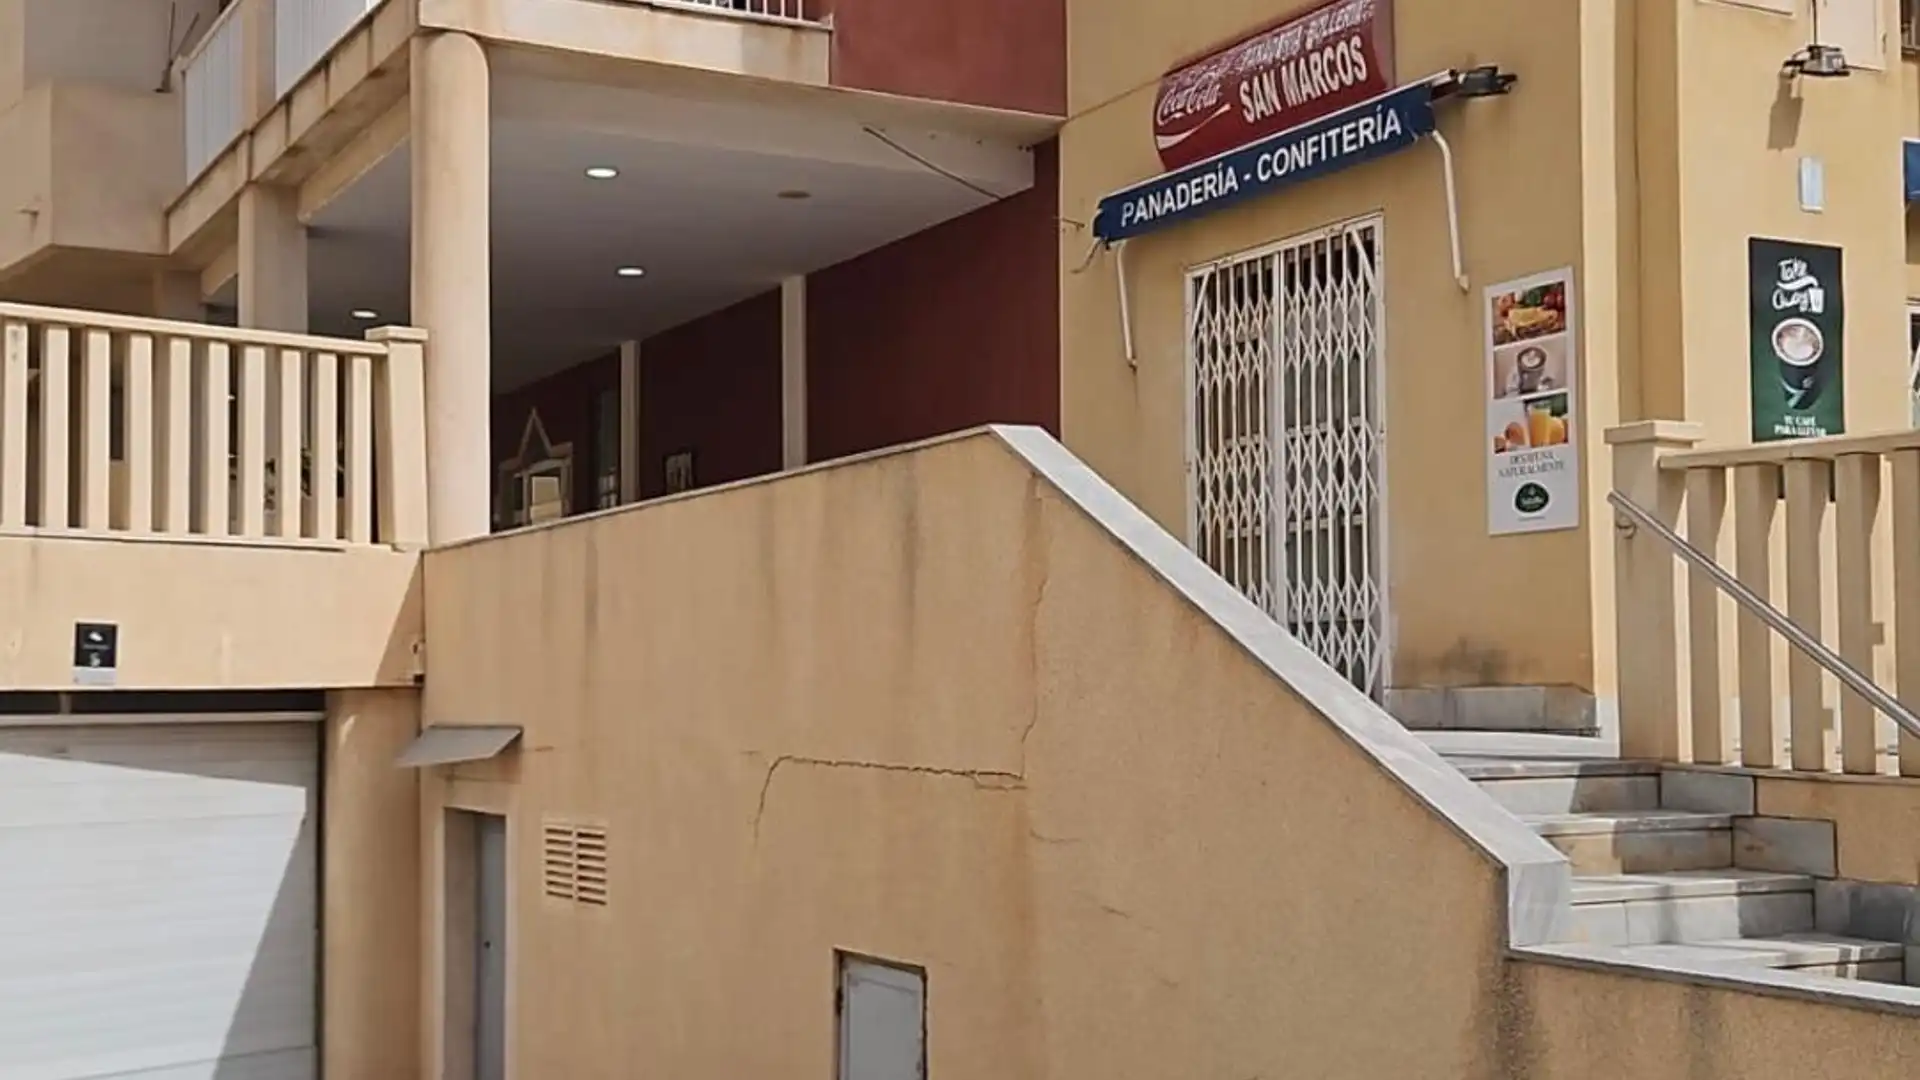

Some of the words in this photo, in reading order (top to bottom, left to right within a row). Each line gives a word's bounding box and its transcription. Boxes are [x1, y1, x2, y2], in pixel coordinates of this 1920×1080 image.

[1240, 67, 1281, 123] SAN
[1281, 35, 1367, 108] MARCOS
[1121, 163, 1239, 228] PANADERÍA
[1257, 104, 1402, 182] CONFITERÍA
